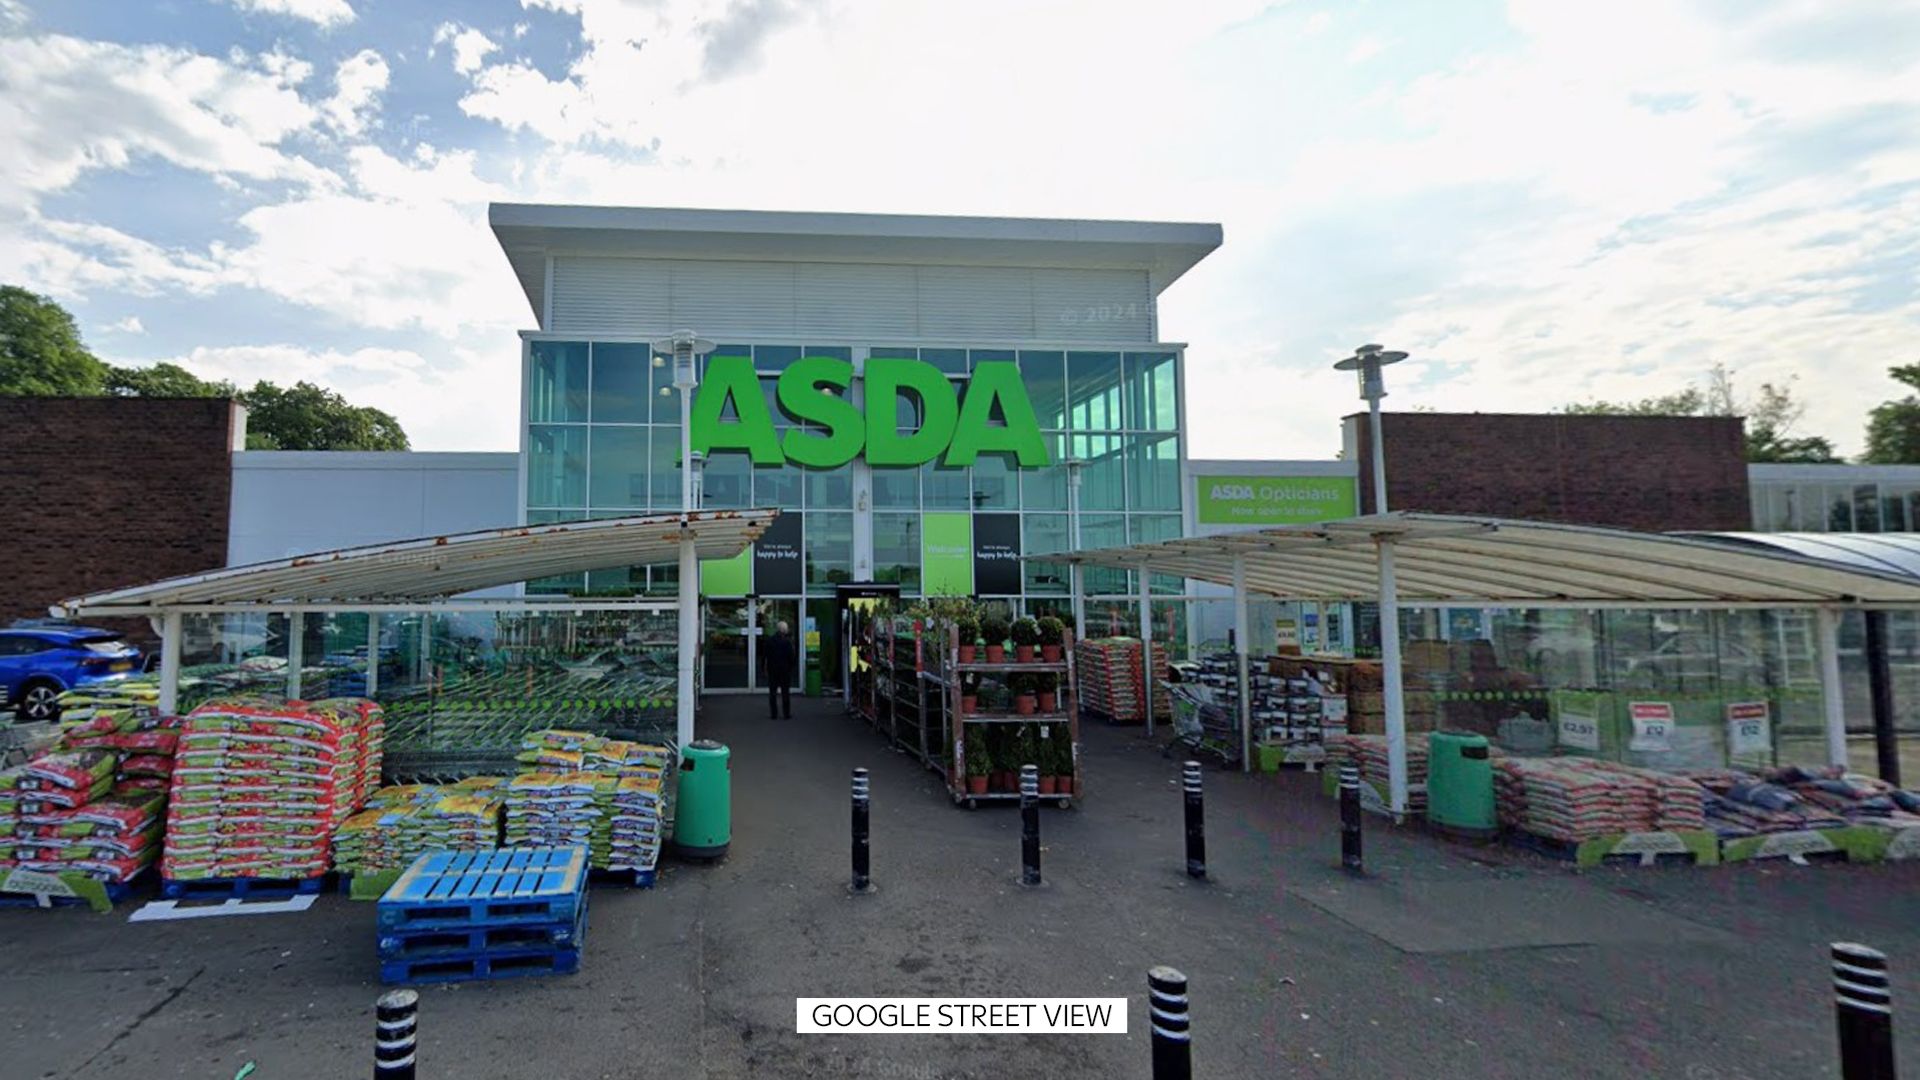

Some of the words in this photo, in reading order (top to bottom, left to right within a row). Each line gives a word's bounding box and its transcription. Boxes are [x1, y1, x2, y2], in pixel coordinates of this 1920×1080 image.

[677, 356, 1051, 467] ASDA
[1211, 485, 1254, 500] ASDA
[1259, 485, 1339, 502] Opticians
[757, 550, 777, 560] happy
[777, 550, 784, 559] to
[784, 550, 799, 560] help
[976, 551, 996, 560] happy
[996, 551, 1003, 559] to
[1003, 551, 1018, 561] help
